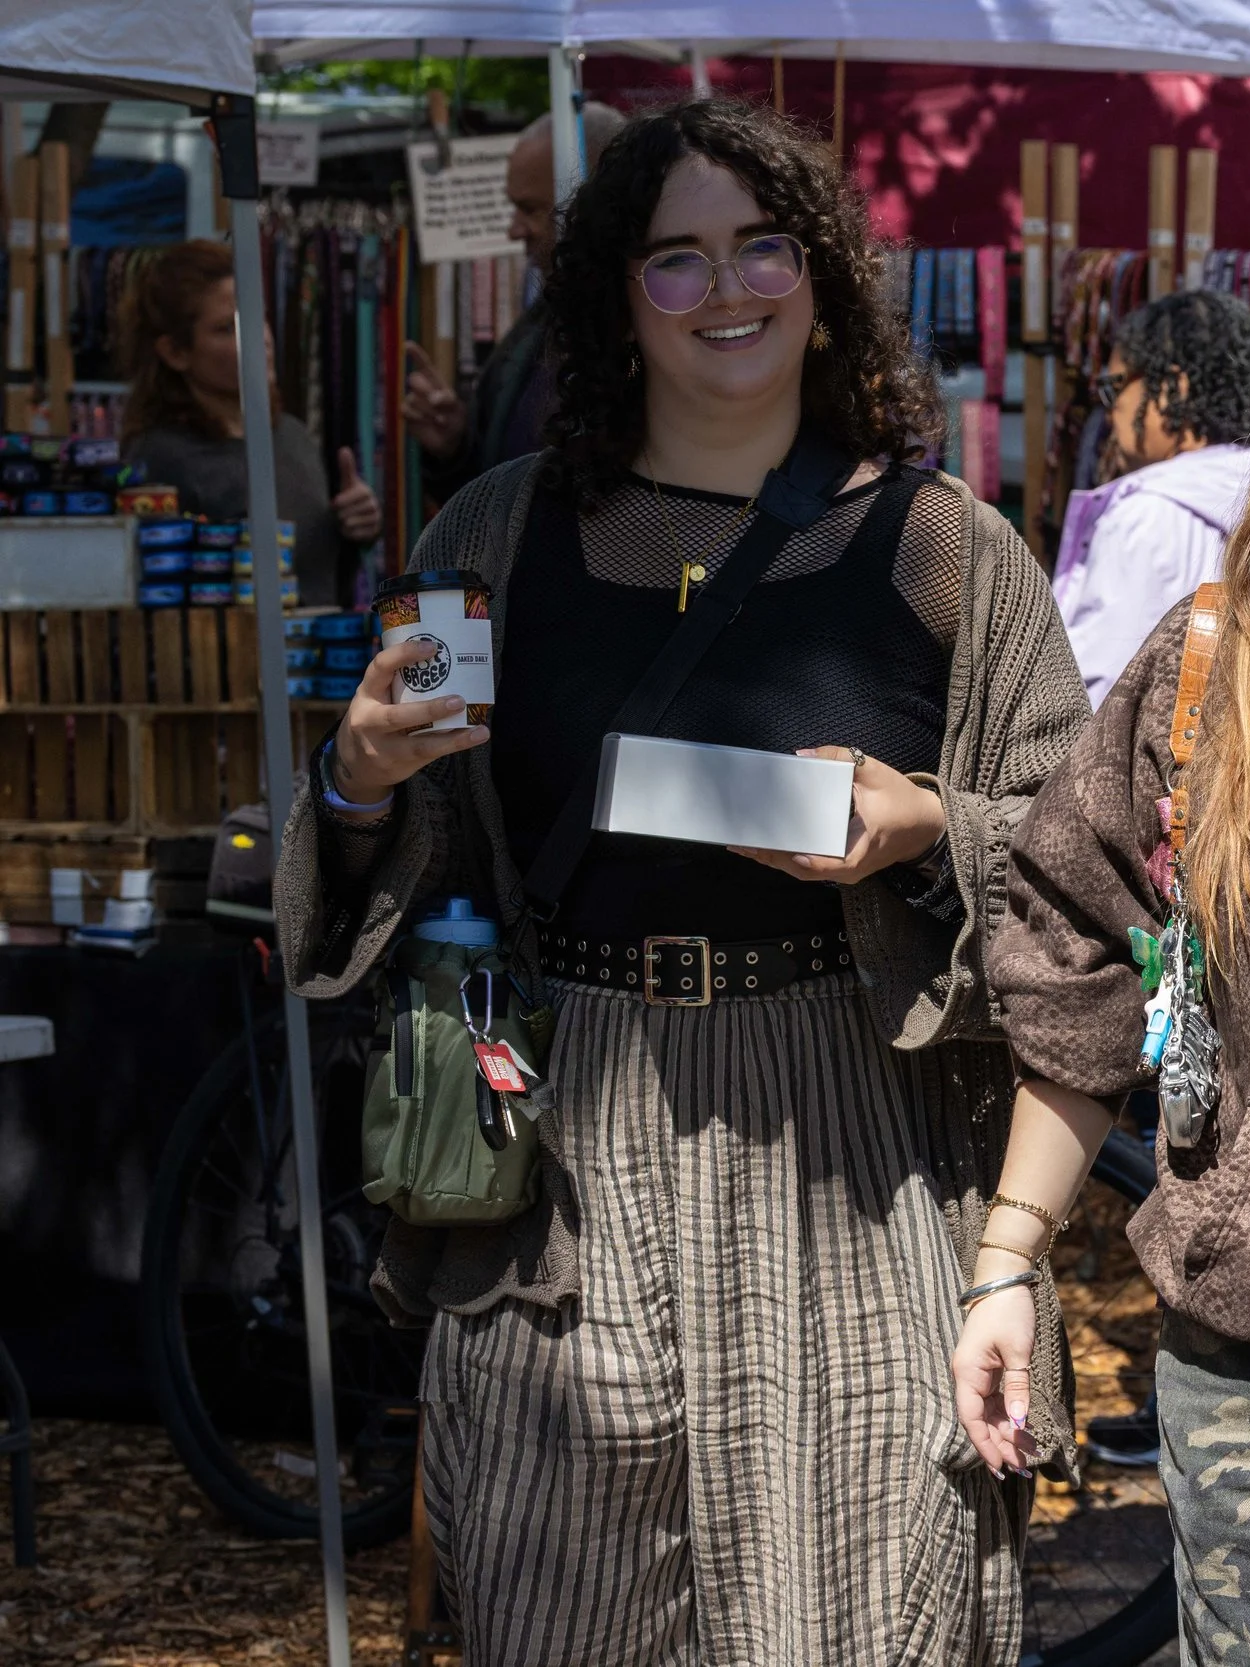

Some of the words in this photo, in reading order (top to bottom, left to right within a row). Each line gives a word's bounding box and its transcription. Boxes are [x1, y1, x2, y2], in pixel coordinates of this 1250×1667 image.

[457, 655, 474, 663] BAKED
[474, 655, 489, 663] DAILY
[403, 662, 448, 689] BAGEL
